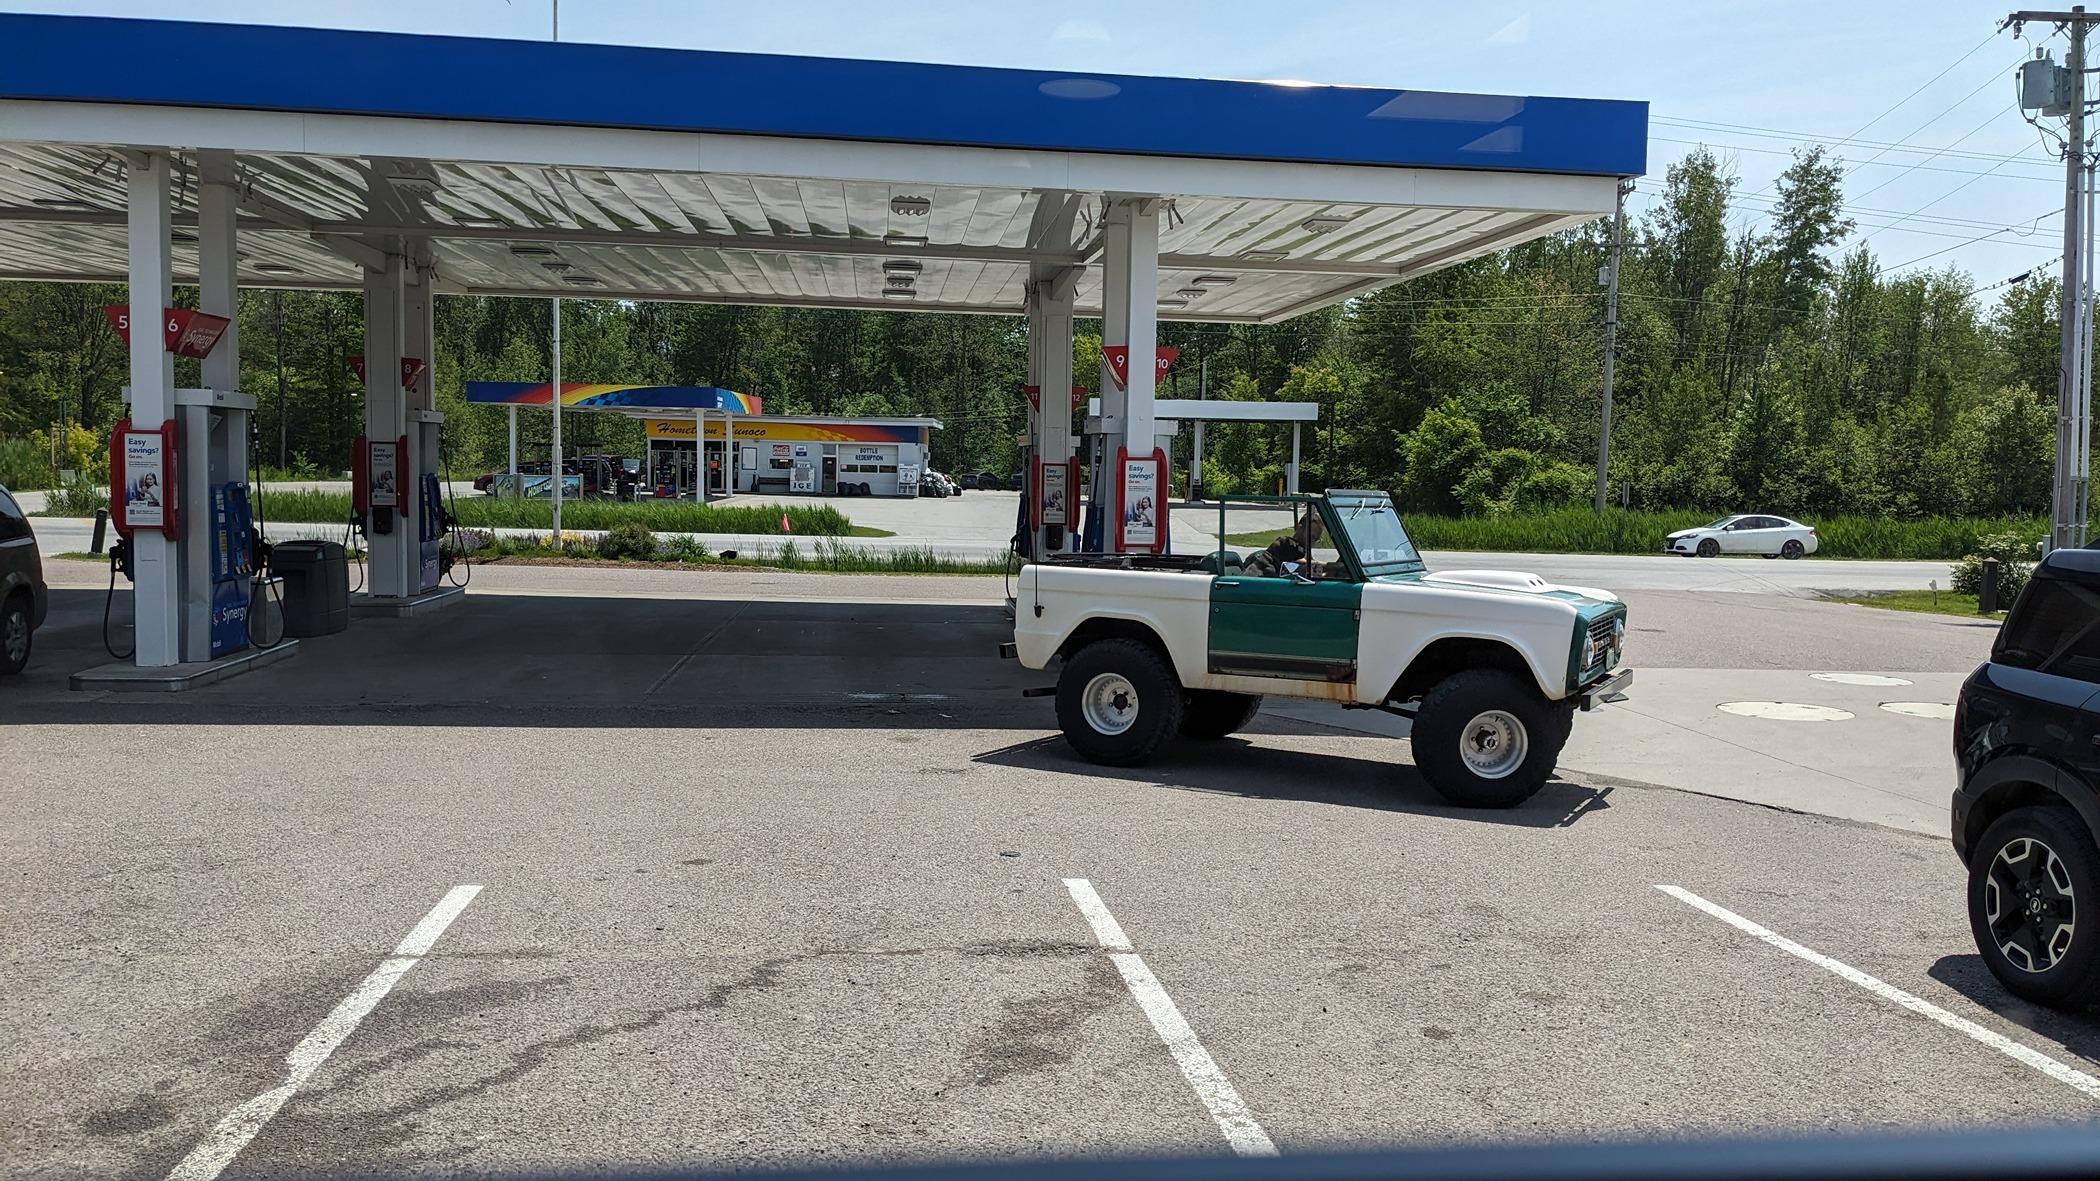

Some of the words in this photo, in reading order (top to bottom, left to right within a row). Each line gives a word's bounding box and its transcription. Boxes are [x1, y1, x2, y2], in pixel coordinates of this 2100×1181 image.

[119, 315, 129, 329] 5
[168, 318, 179, 332] 6
[1116, 354, 1125, 368] 9
[1156, 358, 1169, 370] 10
[356, 362, 364, 373] 7
[404, 363, 412, 374] 8
[1030, 392, 1039, 401] 11
[1072, 393, 1081, 401] 12
[723, 424, 766, 436] unoco
[128, 437, 147, 448] Easy
[128, 447, 160, 456] savings?
[1128, 464, 1145, 474] Easy
[222, 606, 248, 625] Synergy
